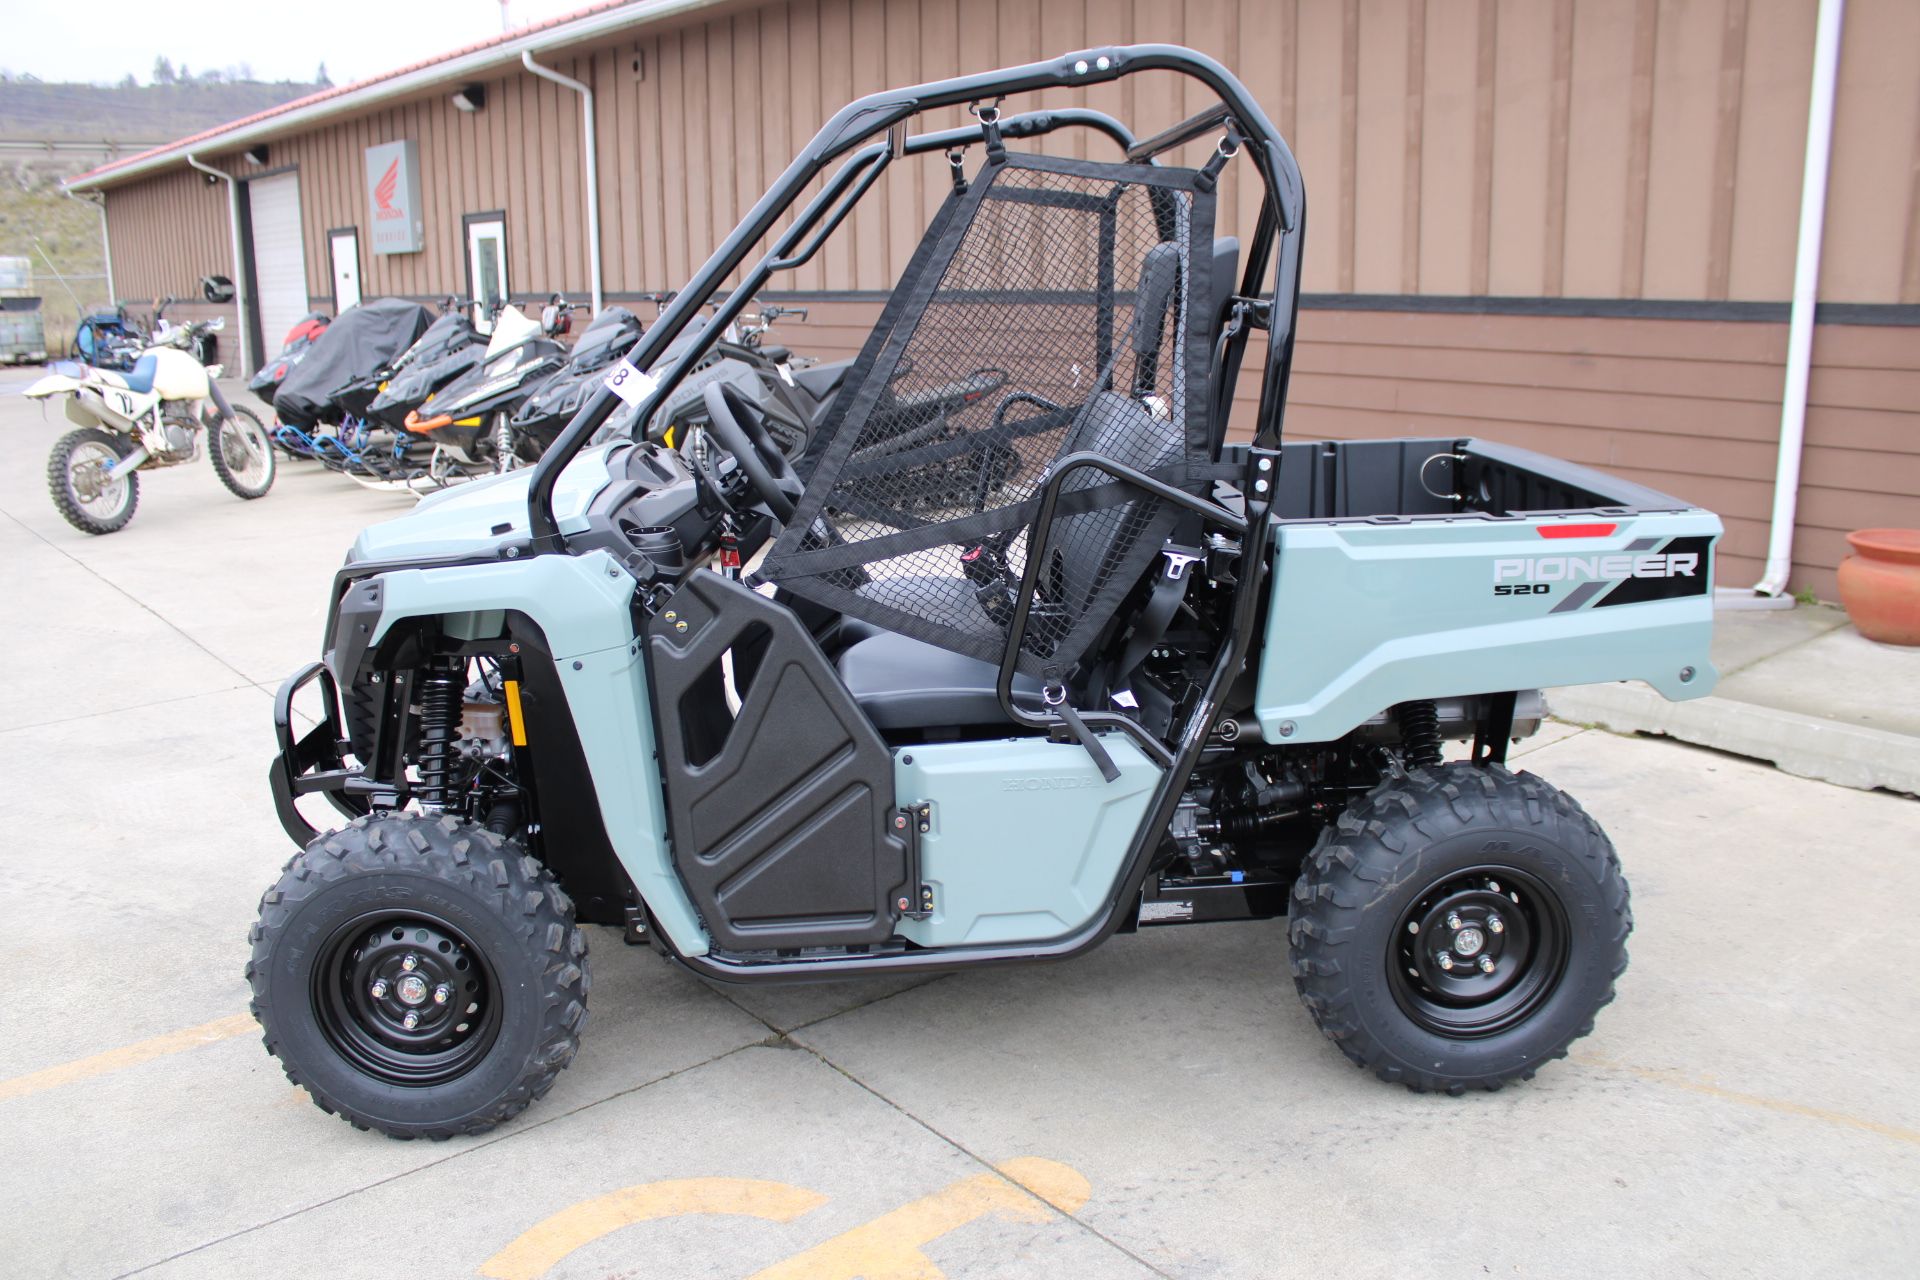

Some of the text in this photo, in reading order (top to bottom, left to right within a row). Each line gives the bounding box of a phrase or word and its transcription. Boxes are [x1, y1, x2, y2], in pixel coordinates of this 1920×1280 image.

[1494, 552, 1699, 582] PIONEER
[1494, 583, 1550, 596] 520
[1001, 776, 1100, 791] HONDA
